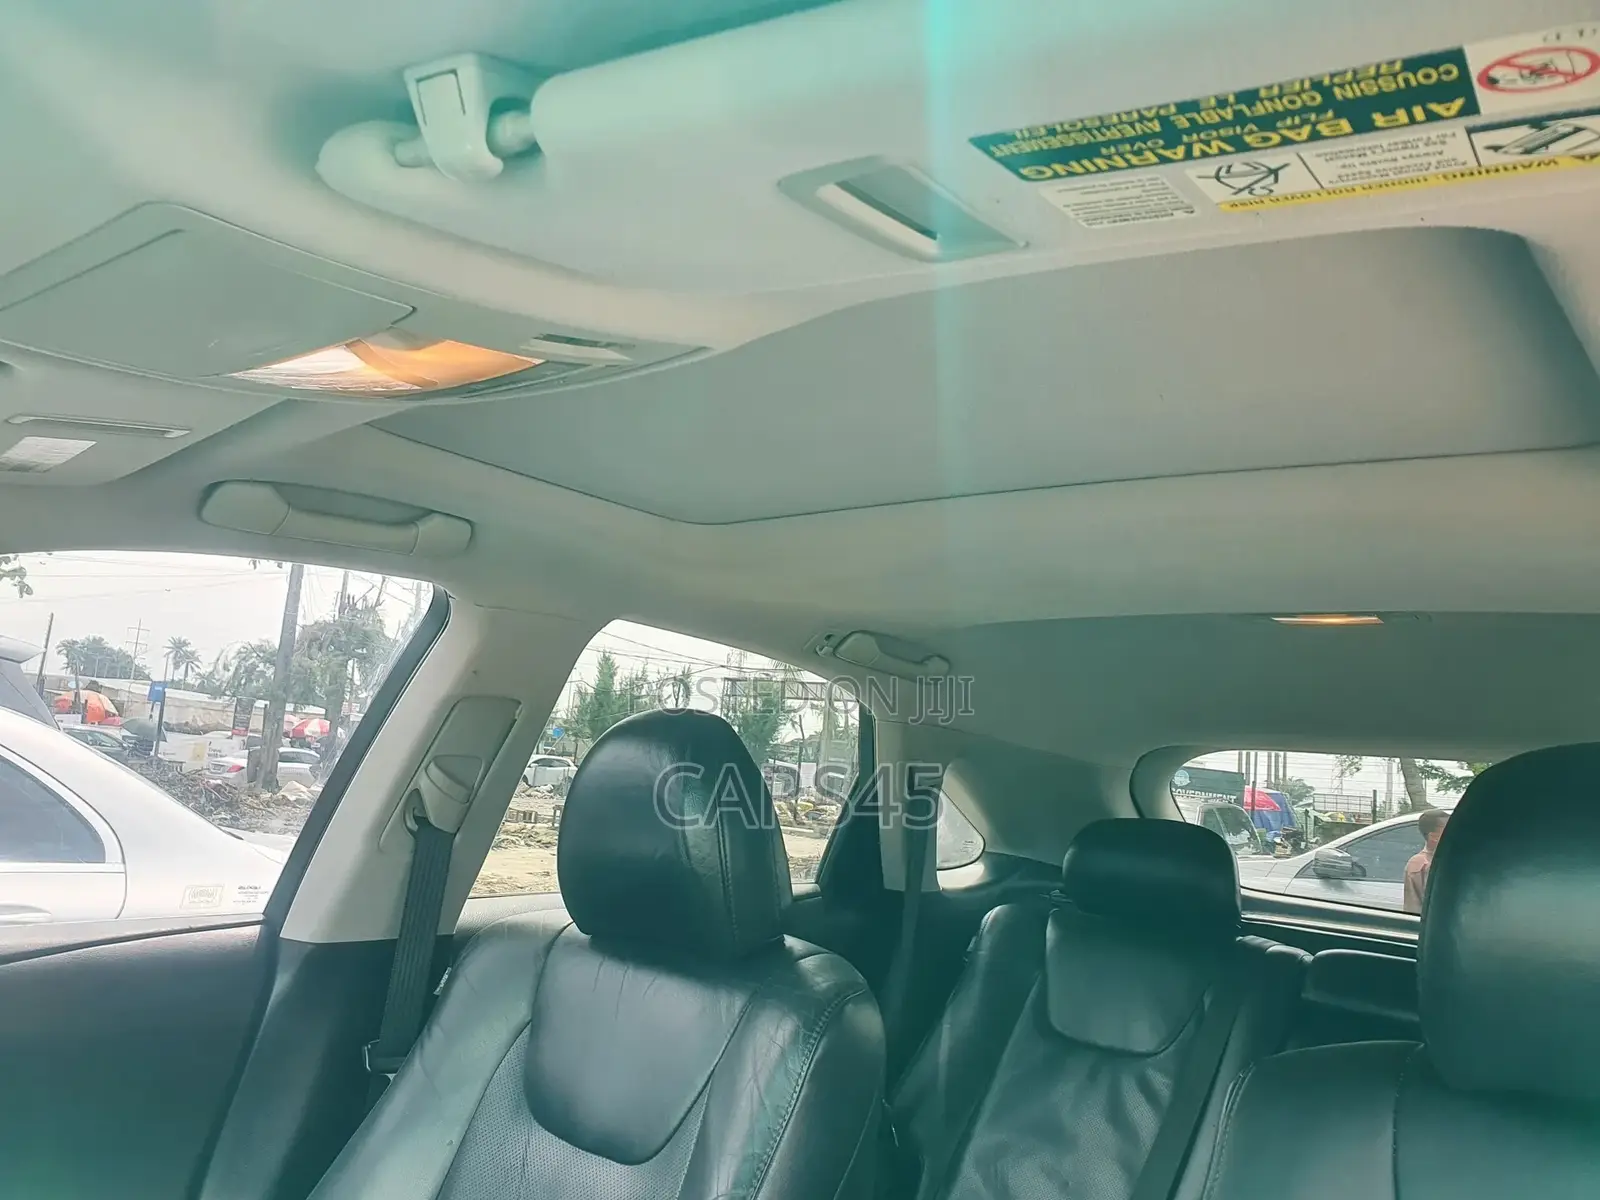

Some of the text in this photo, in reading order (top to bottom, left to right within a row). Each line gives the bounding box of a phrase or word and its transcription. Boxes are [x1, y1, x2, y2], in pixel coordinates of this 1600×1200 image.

[1197, 92, 1235, 110] LE
[1258, 59, 1401, 98] REPLIER
[989, 63, 1459, 157] COUSSIN GONFLABLE AVERTISSEMENT
[1101, 107, 1335, 155] FLIP VISOR OVER
[1018, 96, 1464, 179] AIR BAG WARNING
